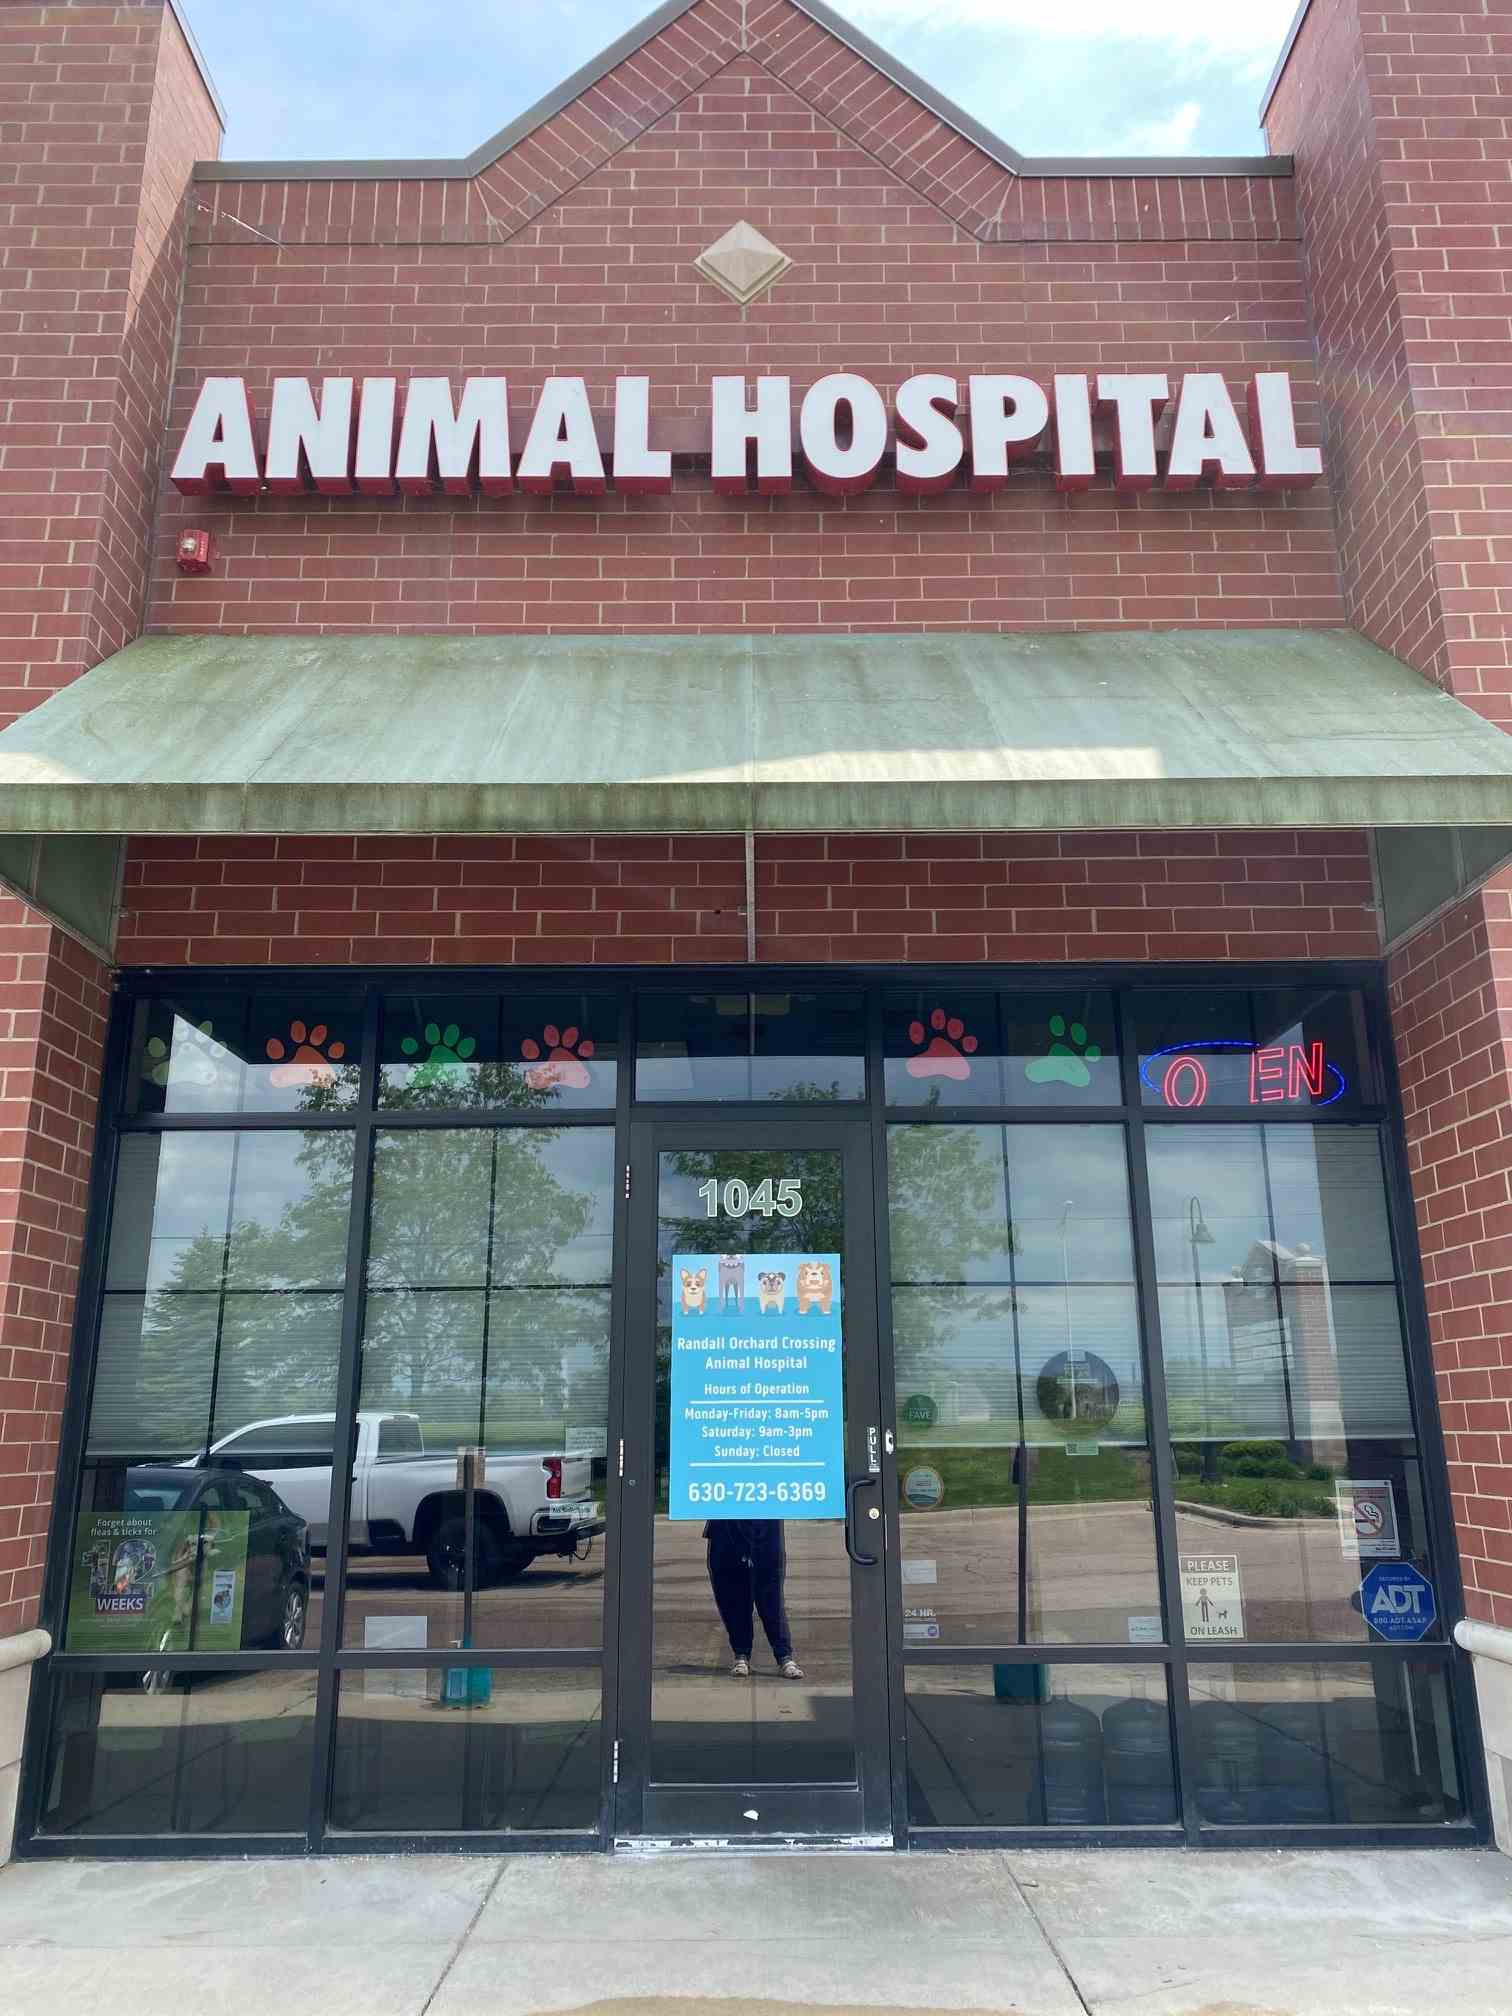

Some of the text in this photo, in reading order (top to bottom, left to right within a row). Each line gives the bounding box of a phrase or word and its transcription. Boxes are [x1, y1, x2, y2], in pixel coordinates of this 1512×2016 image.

[170, 372, 1324, 480] ANIMAL HOSPITAL
[699, 1179, 803, 1218] 1045
[677, 1336, 837, 1352] Randall Orchard Crossing
[705, 1356, 808, 1373] Animal Hospital
[704, 1383, 810, 1397] Hours of Operation
[684, 1407, 829, 1422] Monday-Friday: 8am-5pm
[701, 1425, 813, 1440] Saturday: 9am-3pm
[714, 1445, 801, 1460] Sunday: Closed
[869, 1427, 877, 1464] PULL
[688, 1482, 827, 1502] 630-723-6369
[97, 1517, 152, 1529] Forget about
[90, 1527, 158, 1537] fleas & ticks for
[1187, 1559, 1230, 1571] PLEASE
[1186, 1576, 1233, 1586] KEEP PETS
[97, 1597, 144, 1611] WEEKS
[1370, 1584, 1426, 1614] ADT
[1190, 1625, 1239, 1636] ON LEASH
